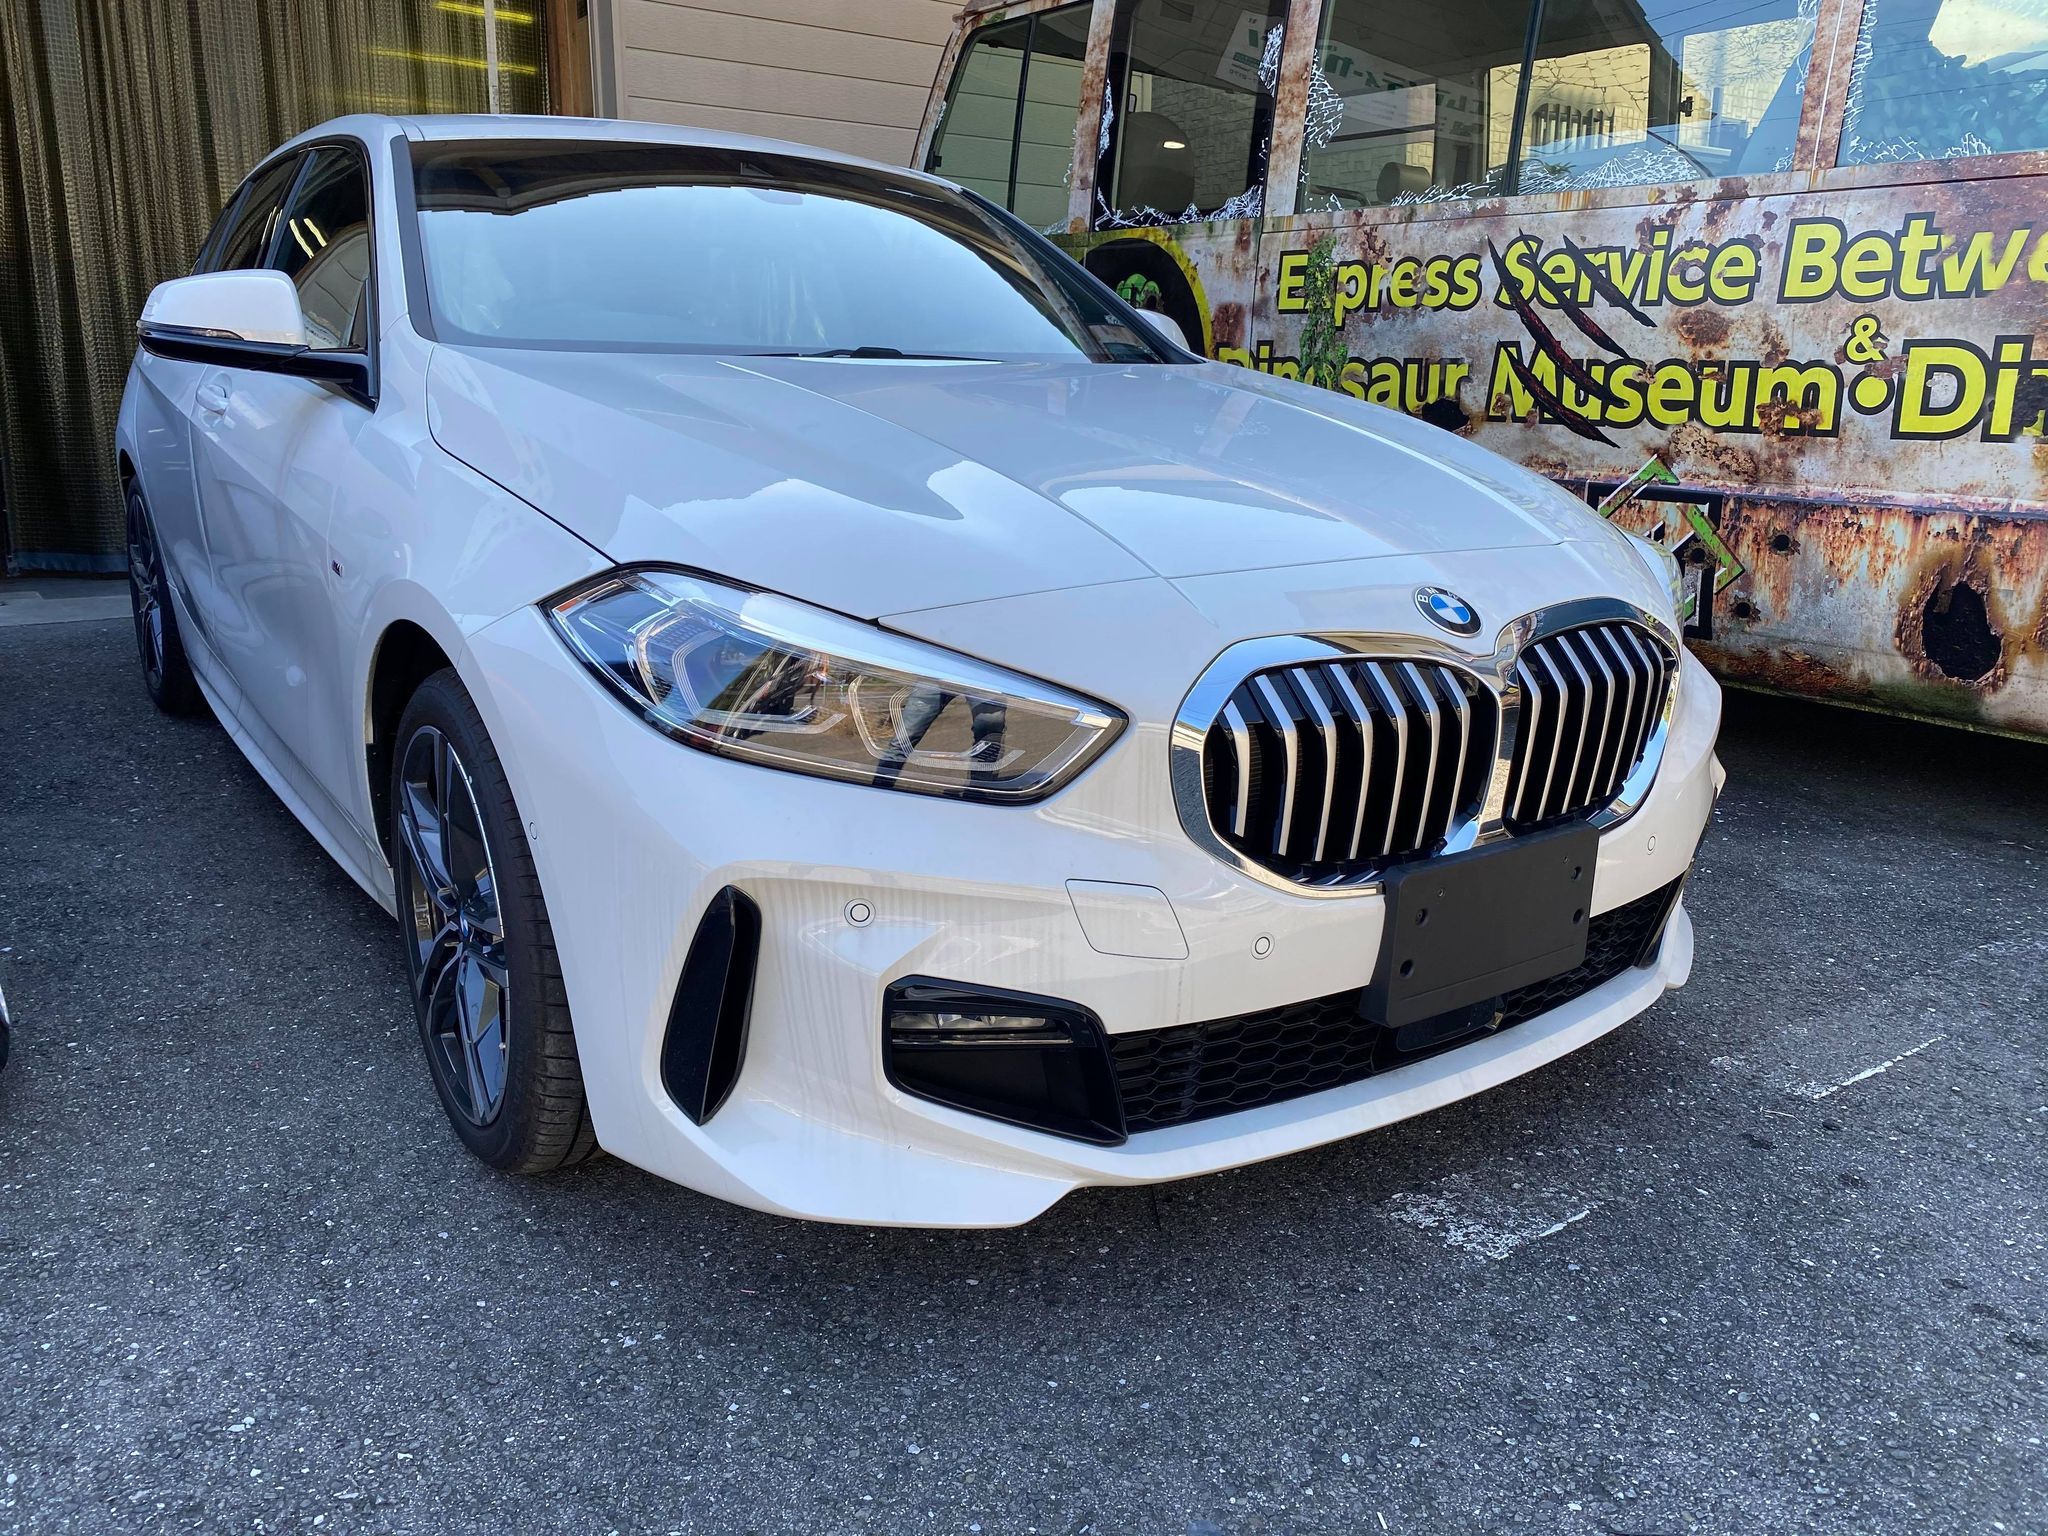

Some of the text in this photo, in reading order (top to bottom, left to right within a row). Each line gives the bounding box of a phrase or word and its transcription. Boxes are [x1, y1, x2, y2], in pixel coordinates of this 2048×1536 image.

[1277, 250, 1482, 330] Epress
[1494, 225, 1761, 306] Service
[1843, 314, 1889, 365] &
[1486, 340, 1844, 438] Museum
[1417, 586, 1459, 603] BMW
